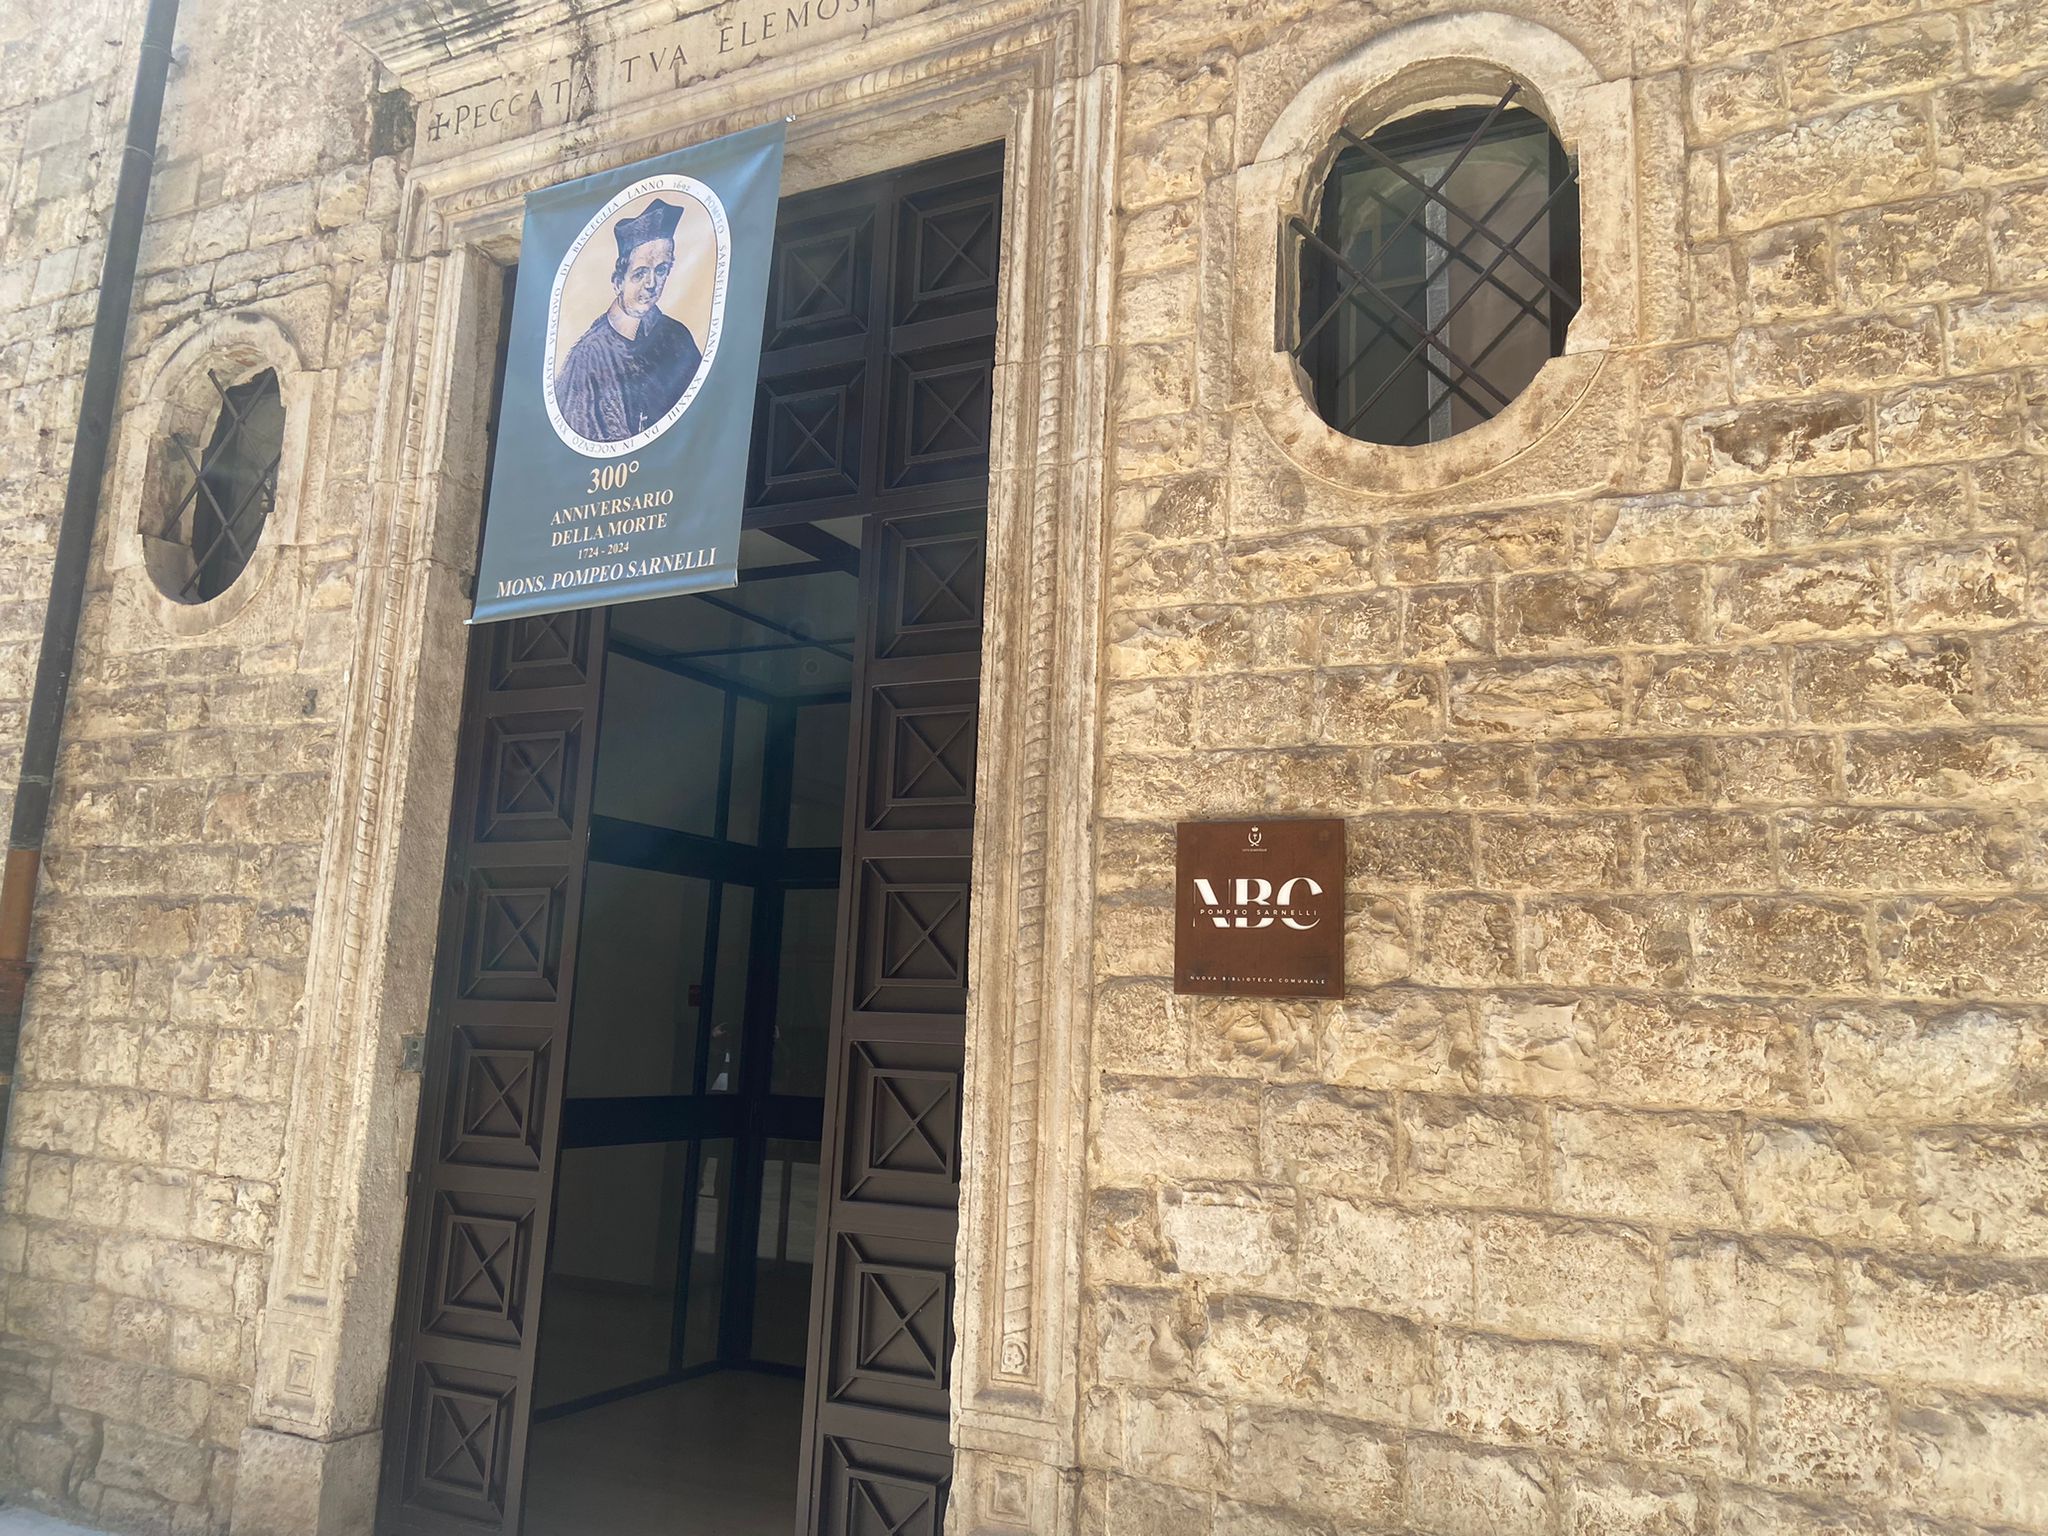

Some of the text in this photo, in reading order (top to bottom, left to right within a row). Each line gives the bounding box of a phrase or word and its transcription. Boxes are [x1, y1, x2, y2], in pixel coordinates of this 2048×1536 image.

[454, 73, 593, 135] PECCATA
[620, 44, 688, 82] TVA
[560, 263, 570, 276] DI
[715, 244, 727, 305] SARNELLI
[549, 287, 561, 345] VESCOVO
[644, 425, 659, 439] DA
[587, 460, 639, 494] 300°
[550, 488, 673, 525] ANNIVERSARIO
[551, 512, 667, 547] DELLA MORTE
[578, 546, 600, 559] 1724
[607, 541, 630, 555] 2024
[496, 547, 718, 598] MONS. POMPEO SARNELLI
